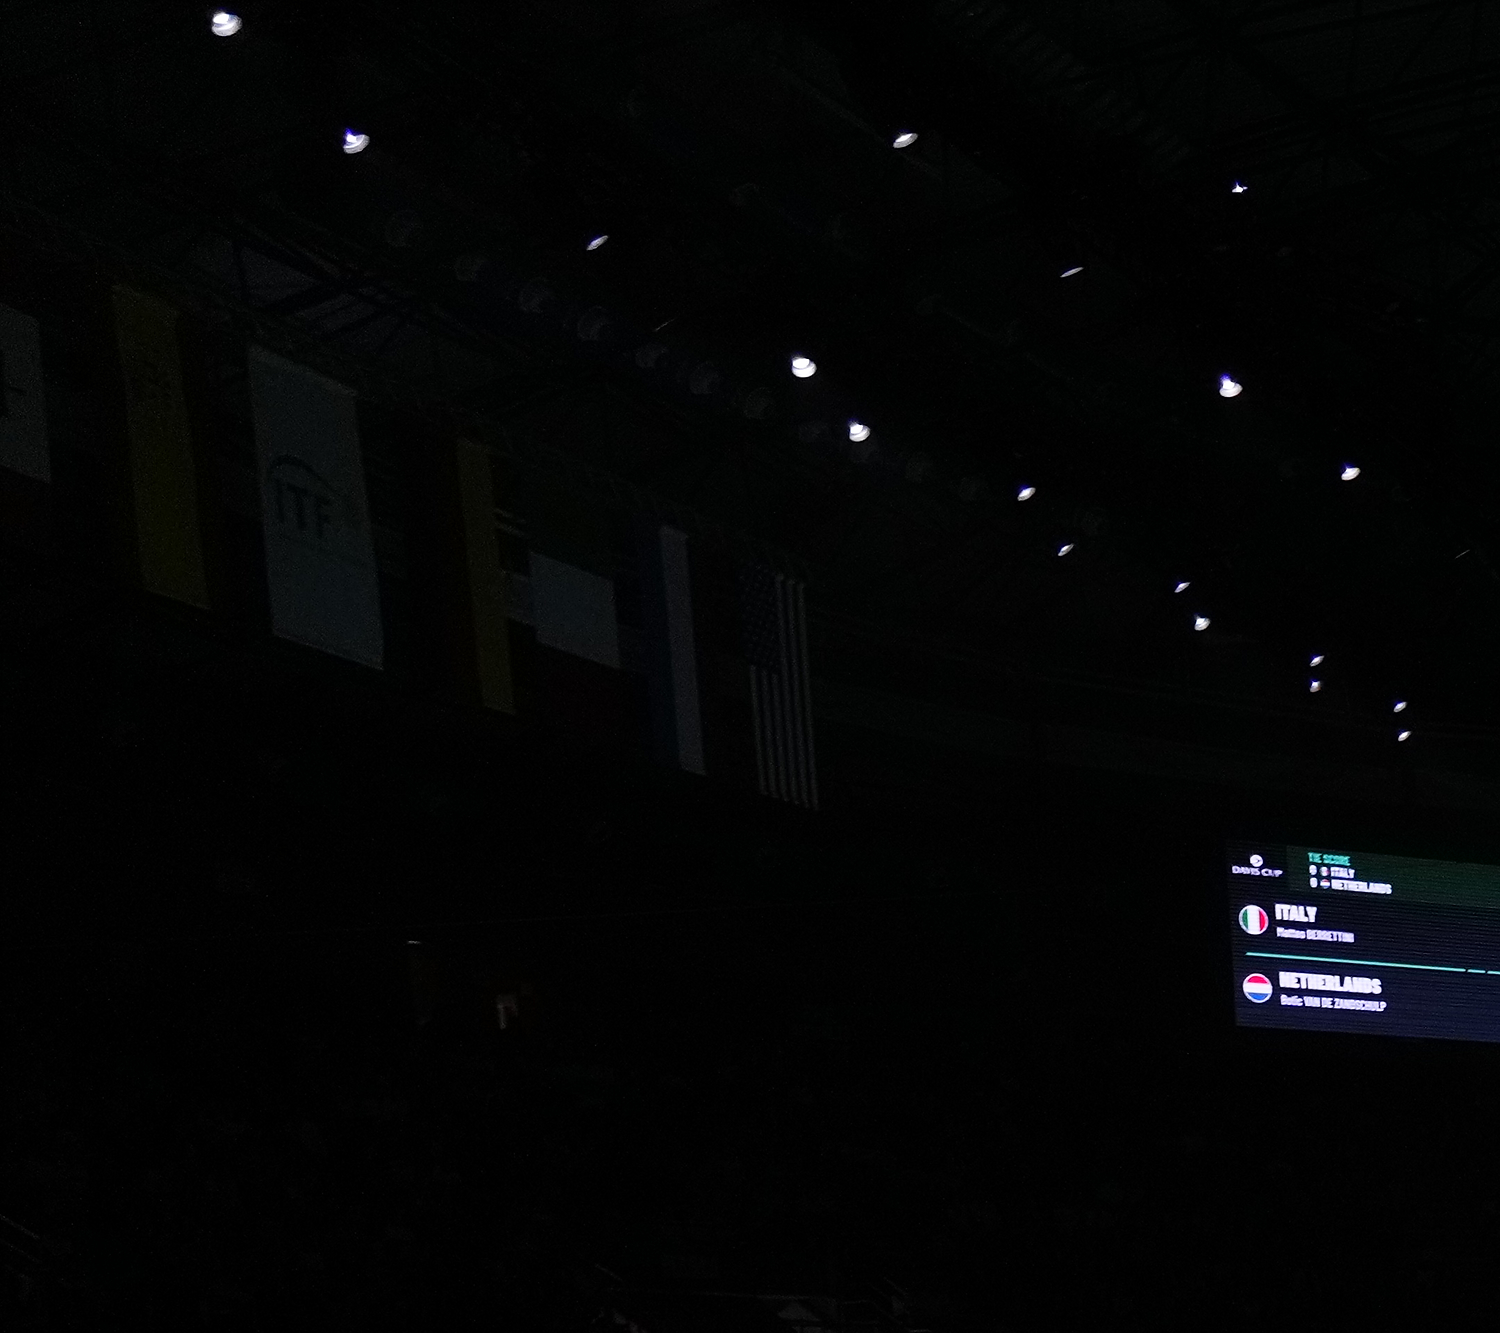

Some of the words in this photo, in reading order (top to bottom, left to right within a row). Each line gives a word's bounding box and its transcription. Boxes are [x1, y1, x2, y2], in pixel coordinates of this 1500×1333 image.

[1330, 866, 1355, 879] ITALY
[1331, 879, 1392, 894] NETHERLANDS
[1275, 903, 1317, 922] ITALY
[1279, 971, 1382, 994] NETHERLANDS
